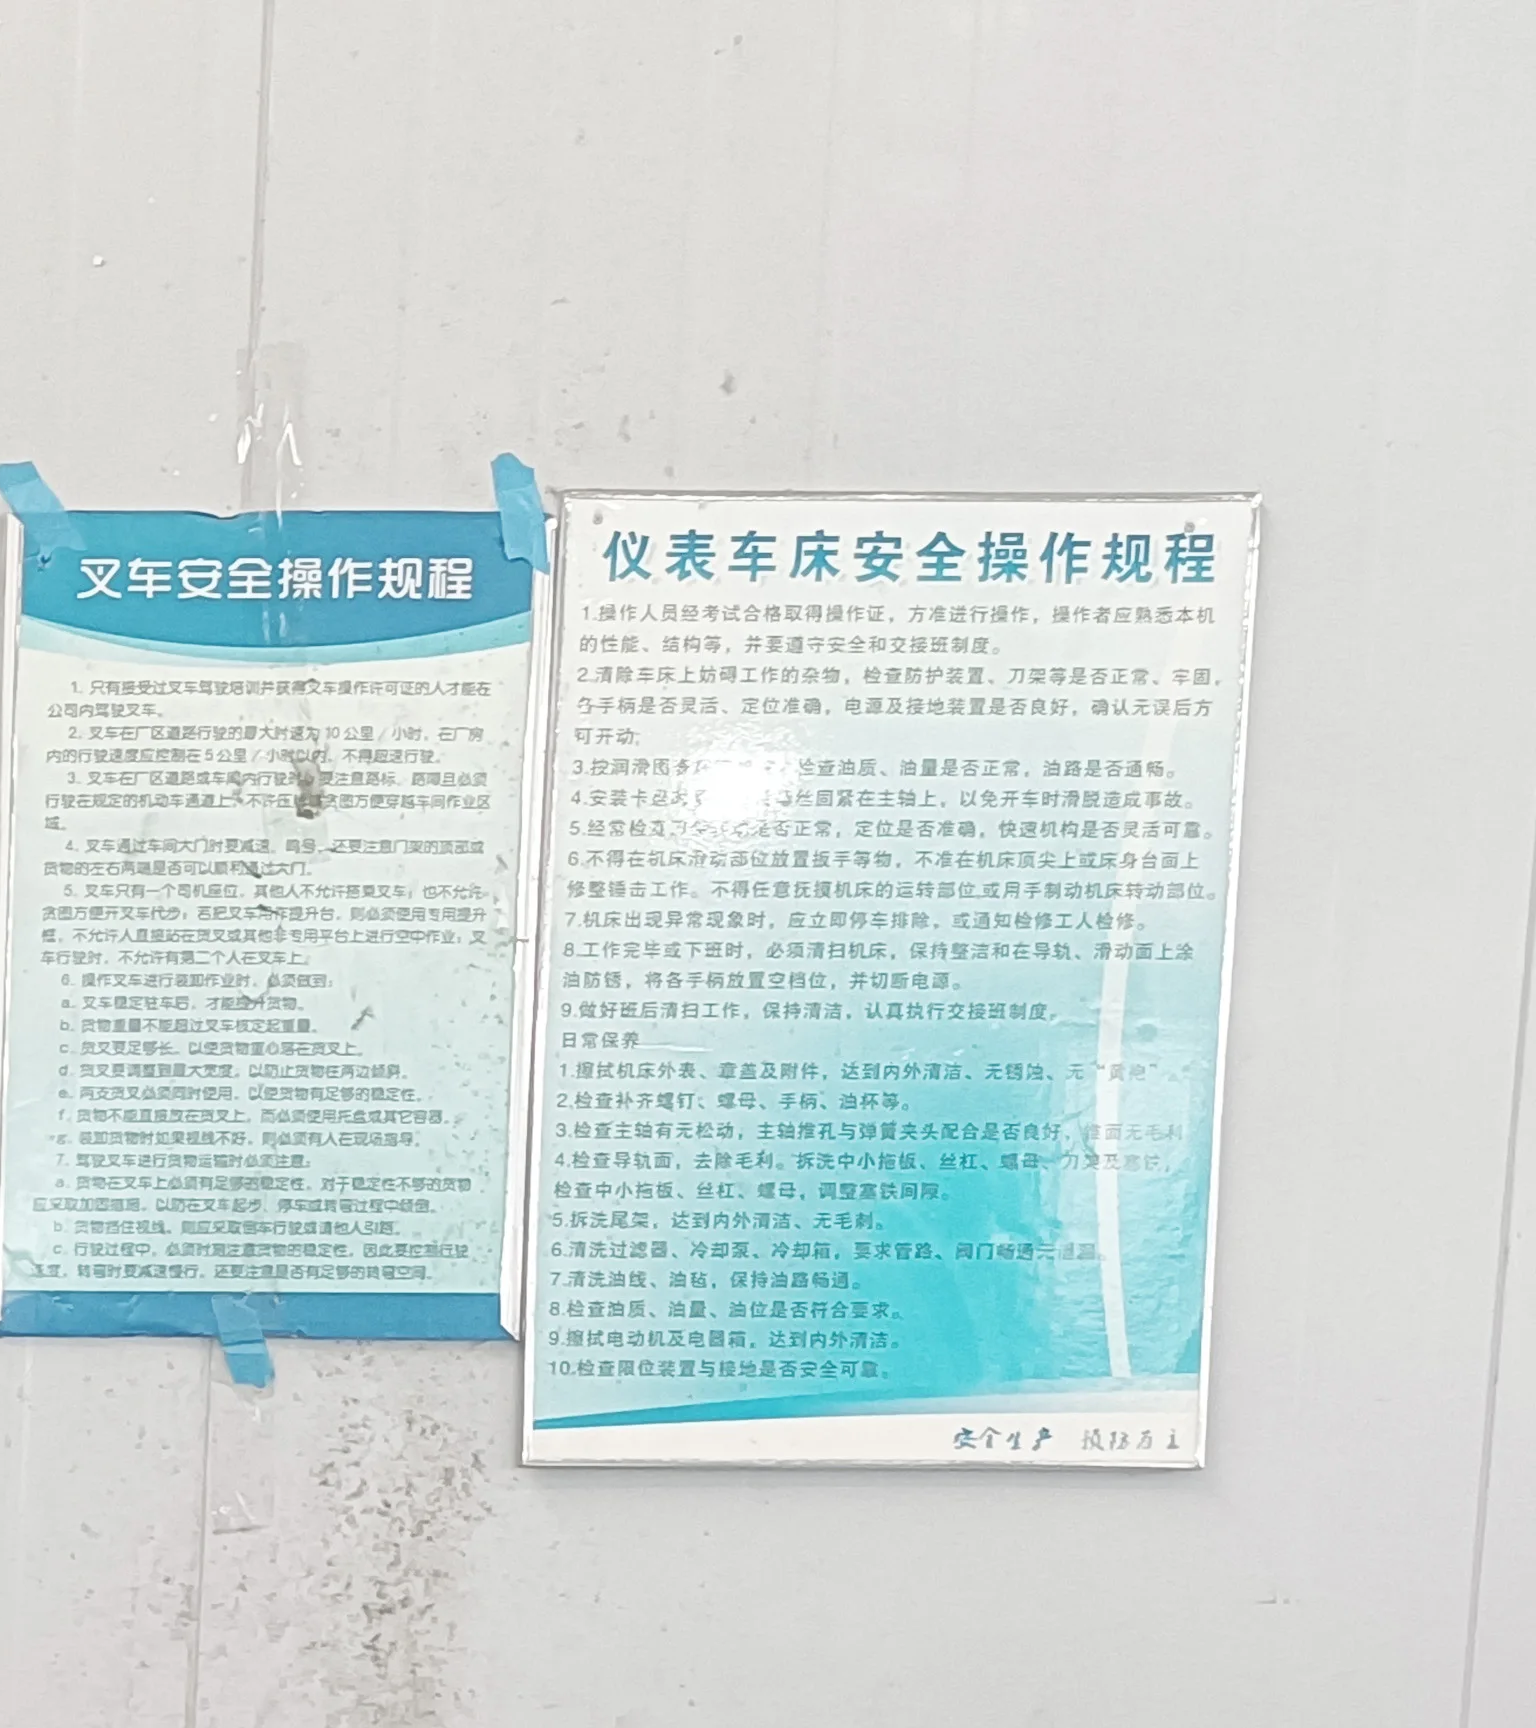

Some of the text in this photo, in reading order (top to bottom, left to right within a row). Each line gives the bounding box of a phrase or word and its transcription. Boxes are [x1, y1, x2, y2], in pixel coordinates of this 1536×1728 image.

[76, 556, 473, 601] 叉车安全操作规程
[602, 528, 1217, 585] 仪表车床安全操作规程
[561, 1031, 640, 1050] 日常保养
